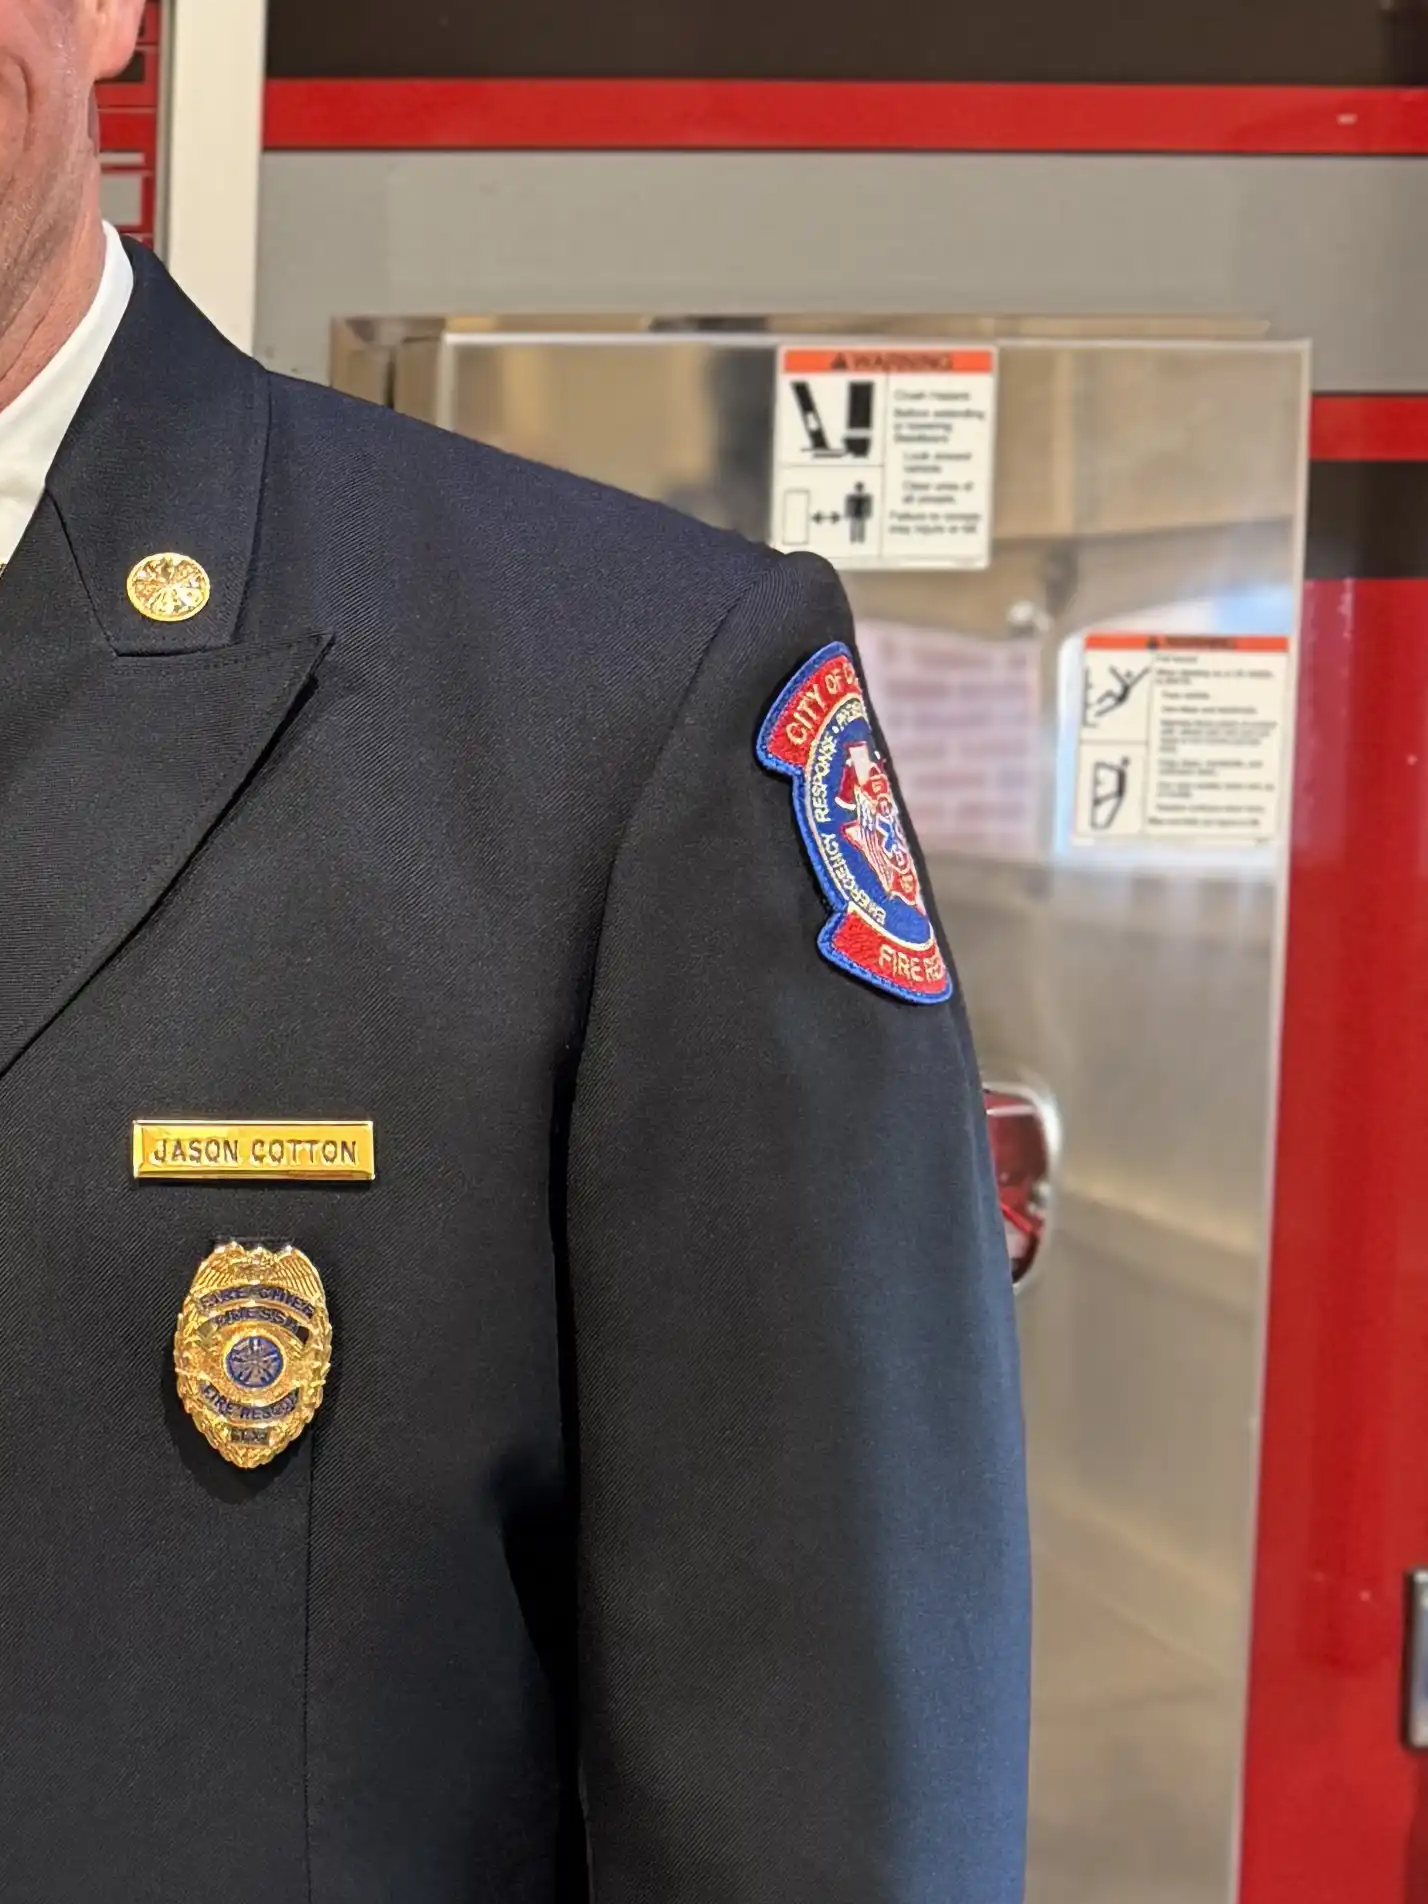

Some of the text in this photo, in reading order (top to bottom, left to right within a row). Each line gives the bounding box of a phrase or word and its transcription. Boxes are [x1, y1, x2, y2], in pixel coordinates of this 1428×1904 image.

[784, 667, 844, 746] CITY OF
[814, 731, 887, 926] EMERGENCY RESPONSE
[878, 943, 924, 982] FIRE
[153, 1139, 357, 1164] JASON COTTON
[201, 1287, 315, 1318] FIRE CHIEF
[202, 1384, 238, 1416] FIRE
